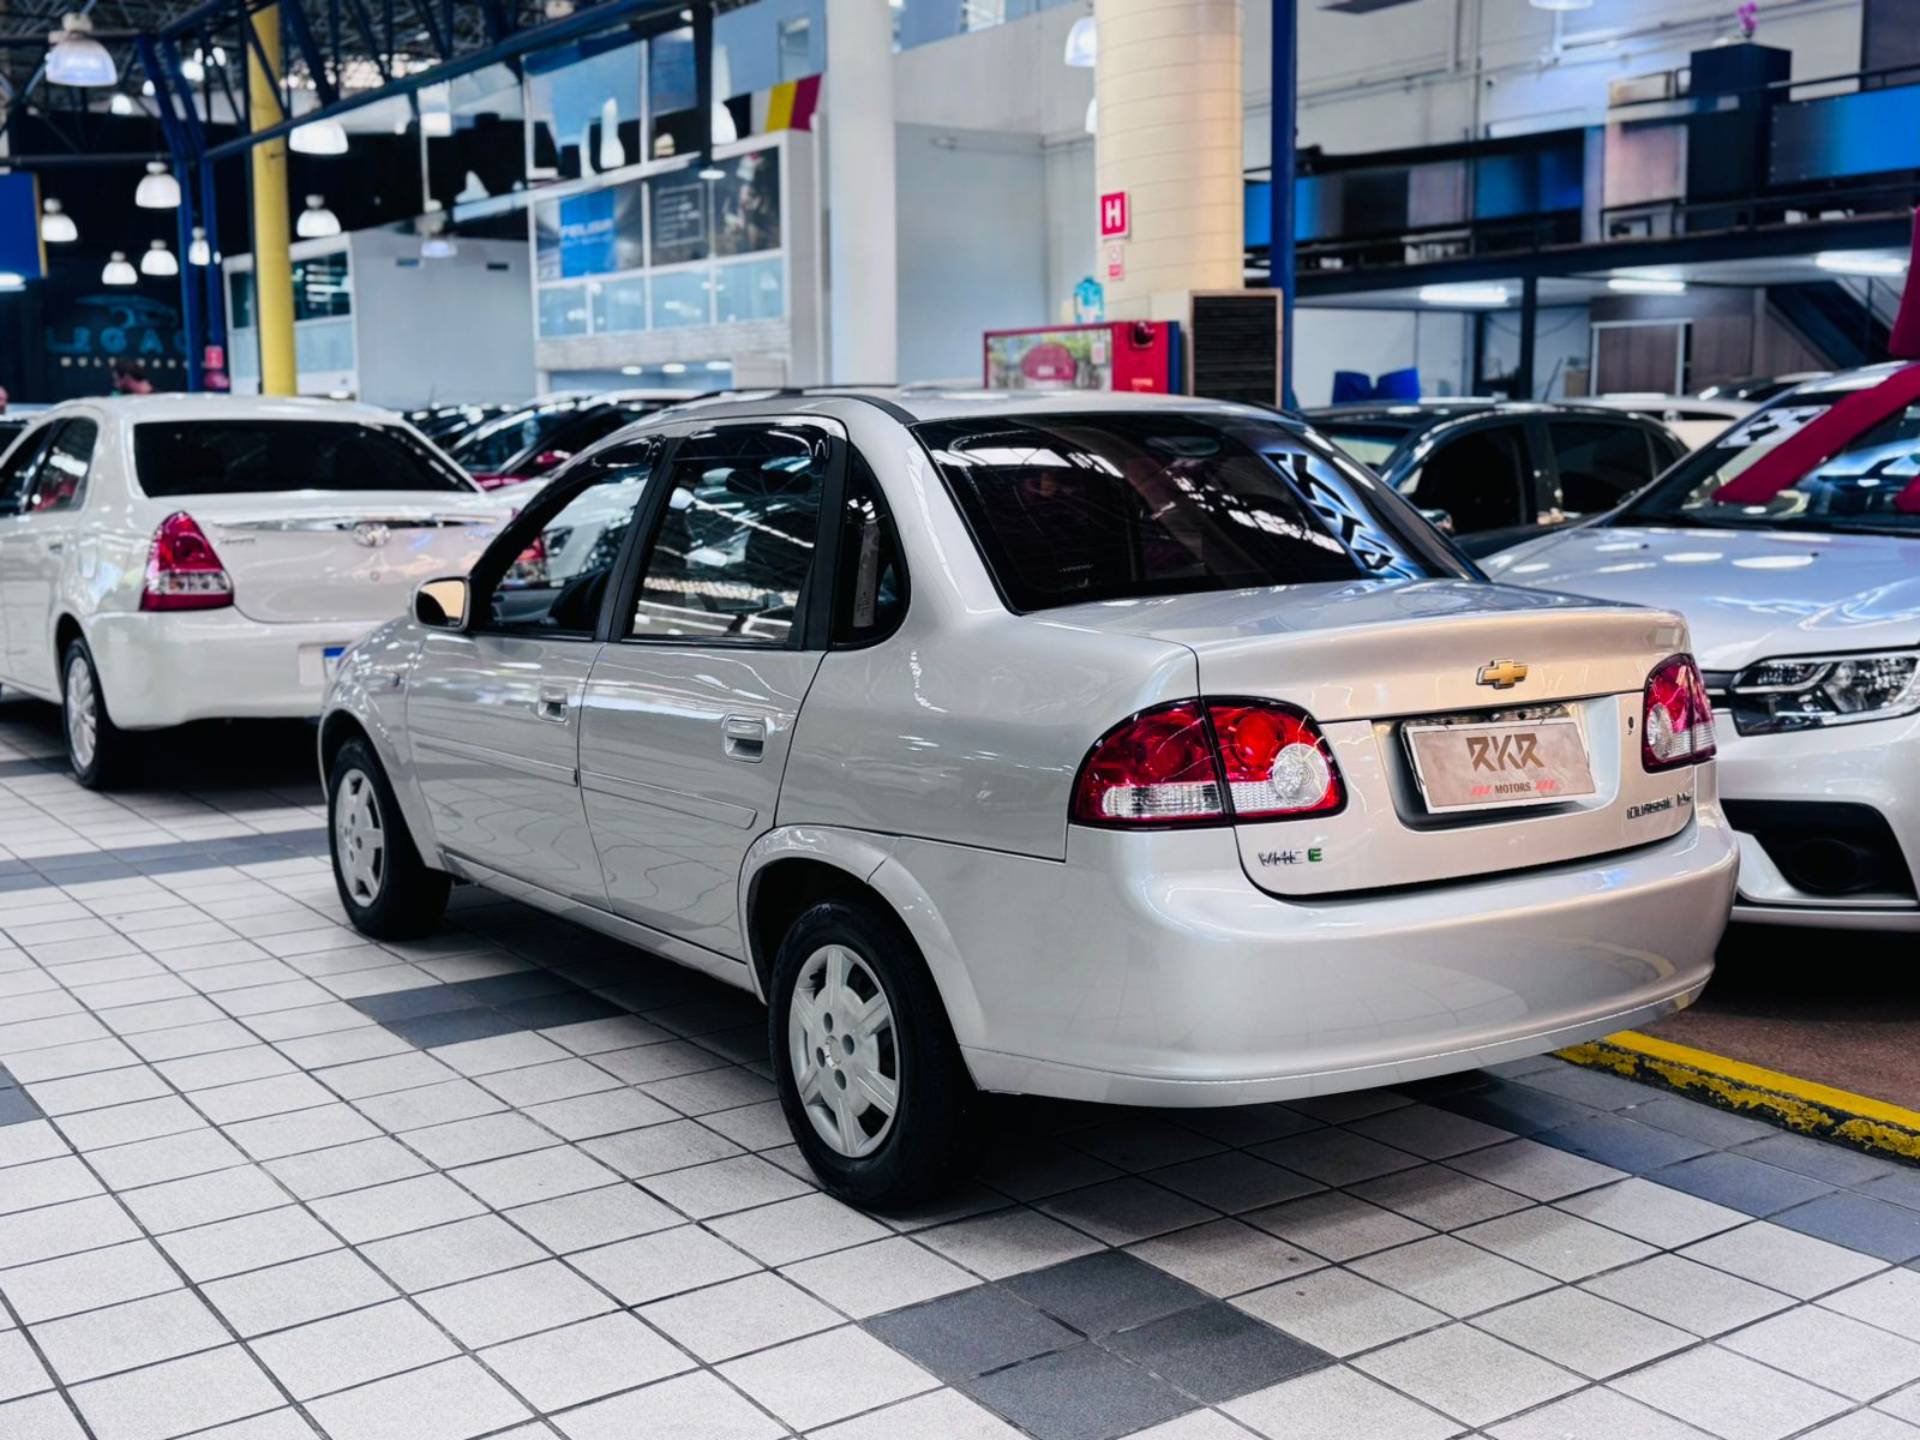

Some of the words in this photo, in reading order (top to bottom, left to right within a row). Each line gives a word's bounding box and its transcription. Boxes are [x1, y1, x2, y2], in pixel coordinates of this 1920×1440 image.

[1105, 198, 1121, 229] H
[1465, 733, 1545, 772] RKR
[1494, 782, 1531, 794] MOTORS
